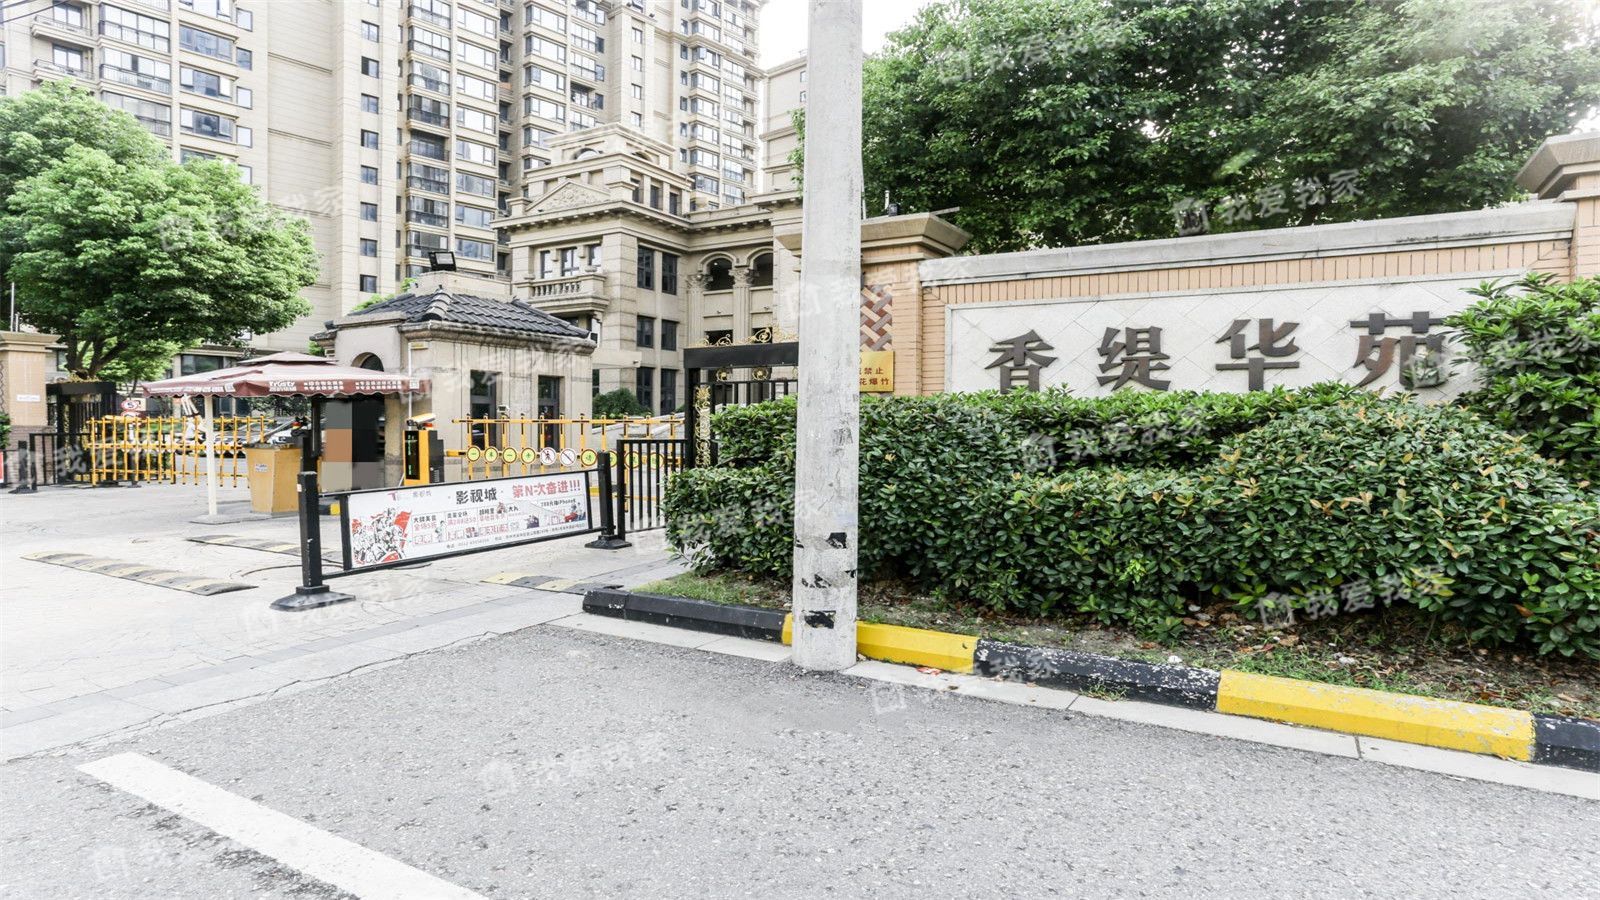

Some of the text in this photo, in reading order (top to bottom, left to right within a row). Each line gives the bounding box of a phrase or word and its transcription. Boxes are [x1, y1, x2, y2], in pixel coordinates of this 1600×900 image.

[984, 310, 1446, 393] 香缇华苑
[456, 488, 498, 505] 影视城
